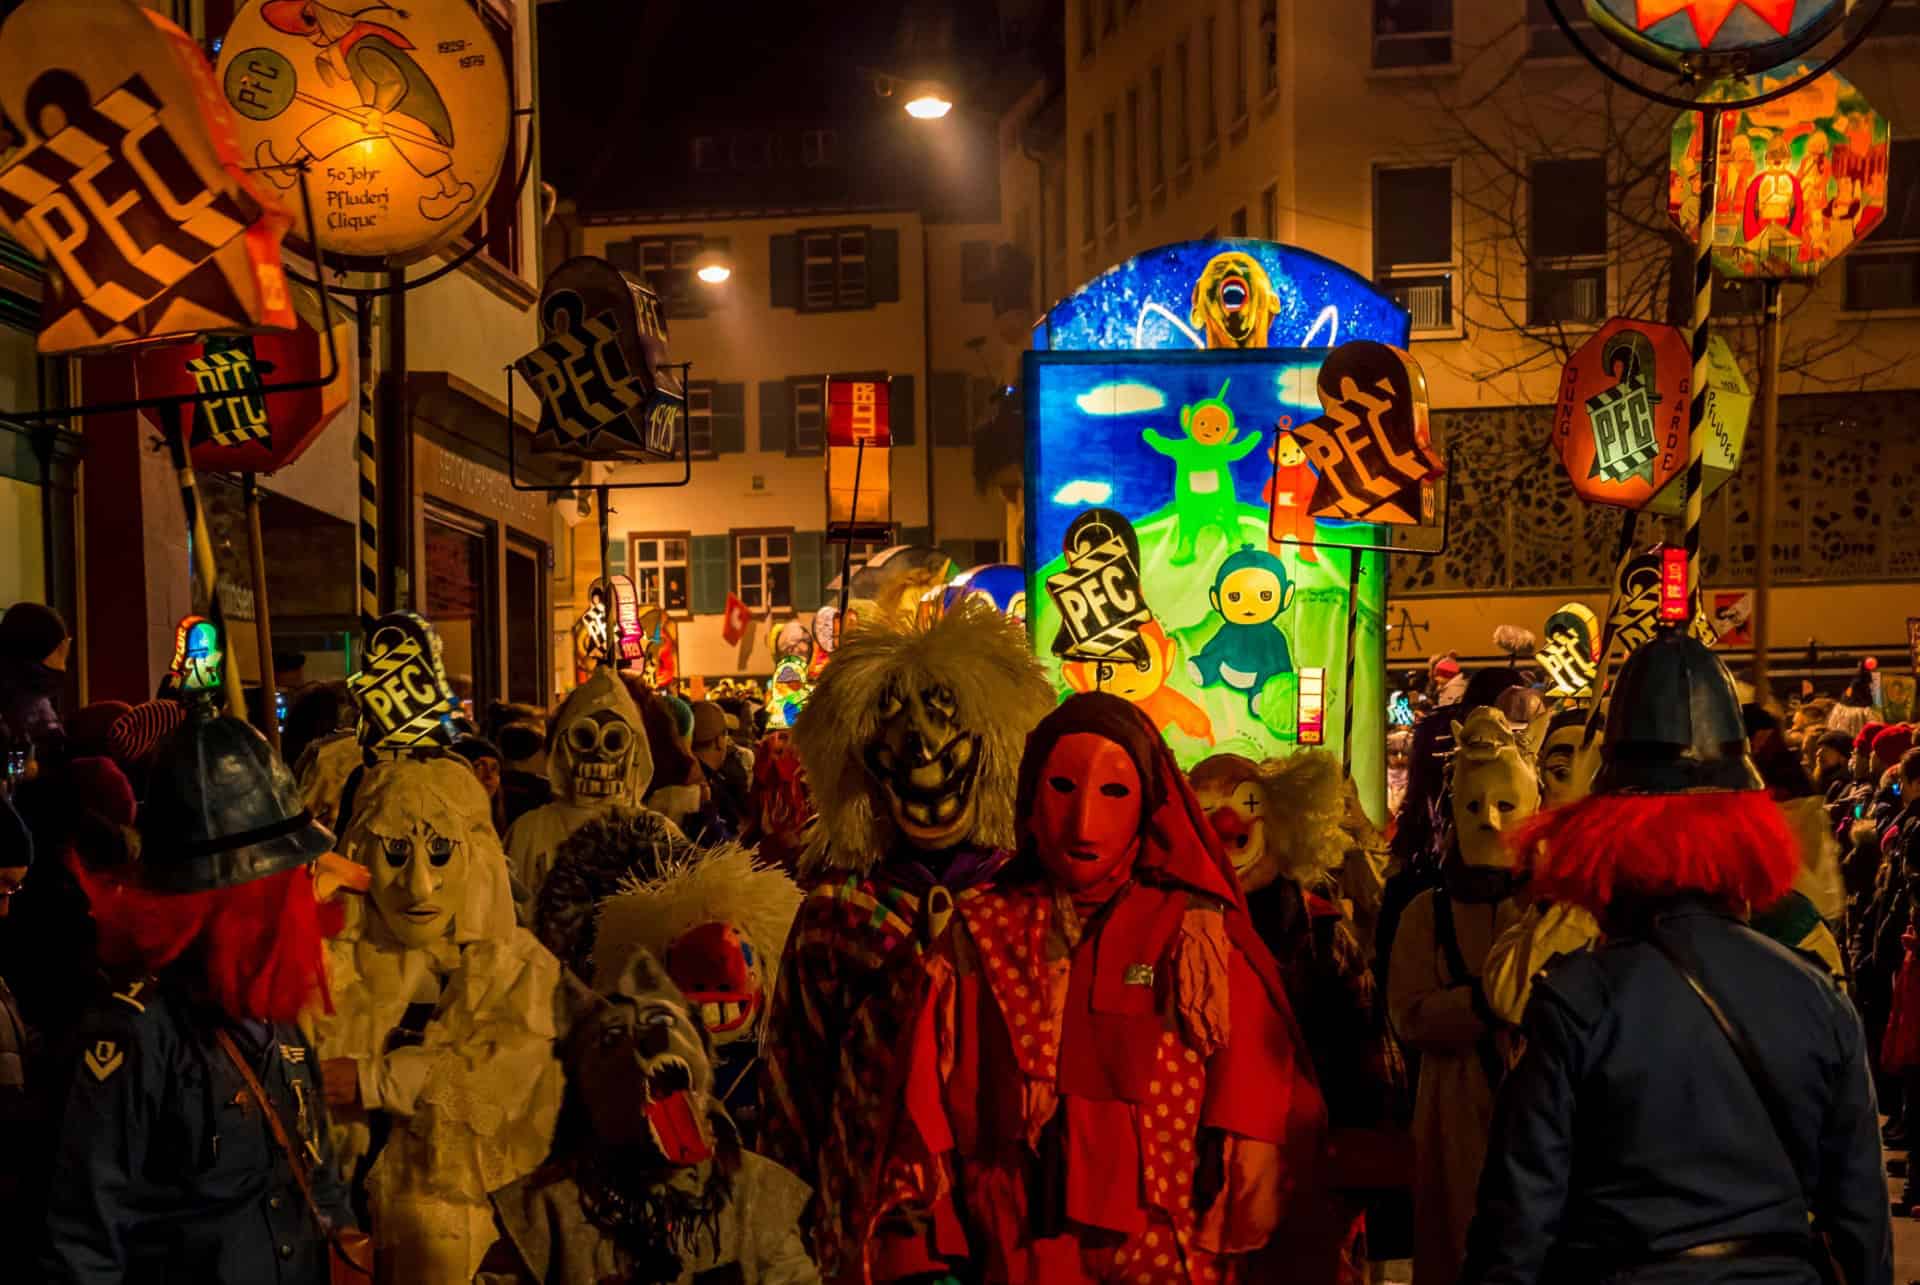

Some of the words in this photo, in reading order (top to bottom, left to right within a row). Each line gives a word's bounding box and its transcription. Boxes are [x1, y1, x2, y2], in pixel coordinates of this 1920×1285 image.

[532, 333, 639, 430] PFC
[1302, 400, 1420, 502] PFC
[1595, 394, 1652, 463] PFC
[1058, 565, 1137, 640] PFC
[363, 664, 437, 731] PFC
